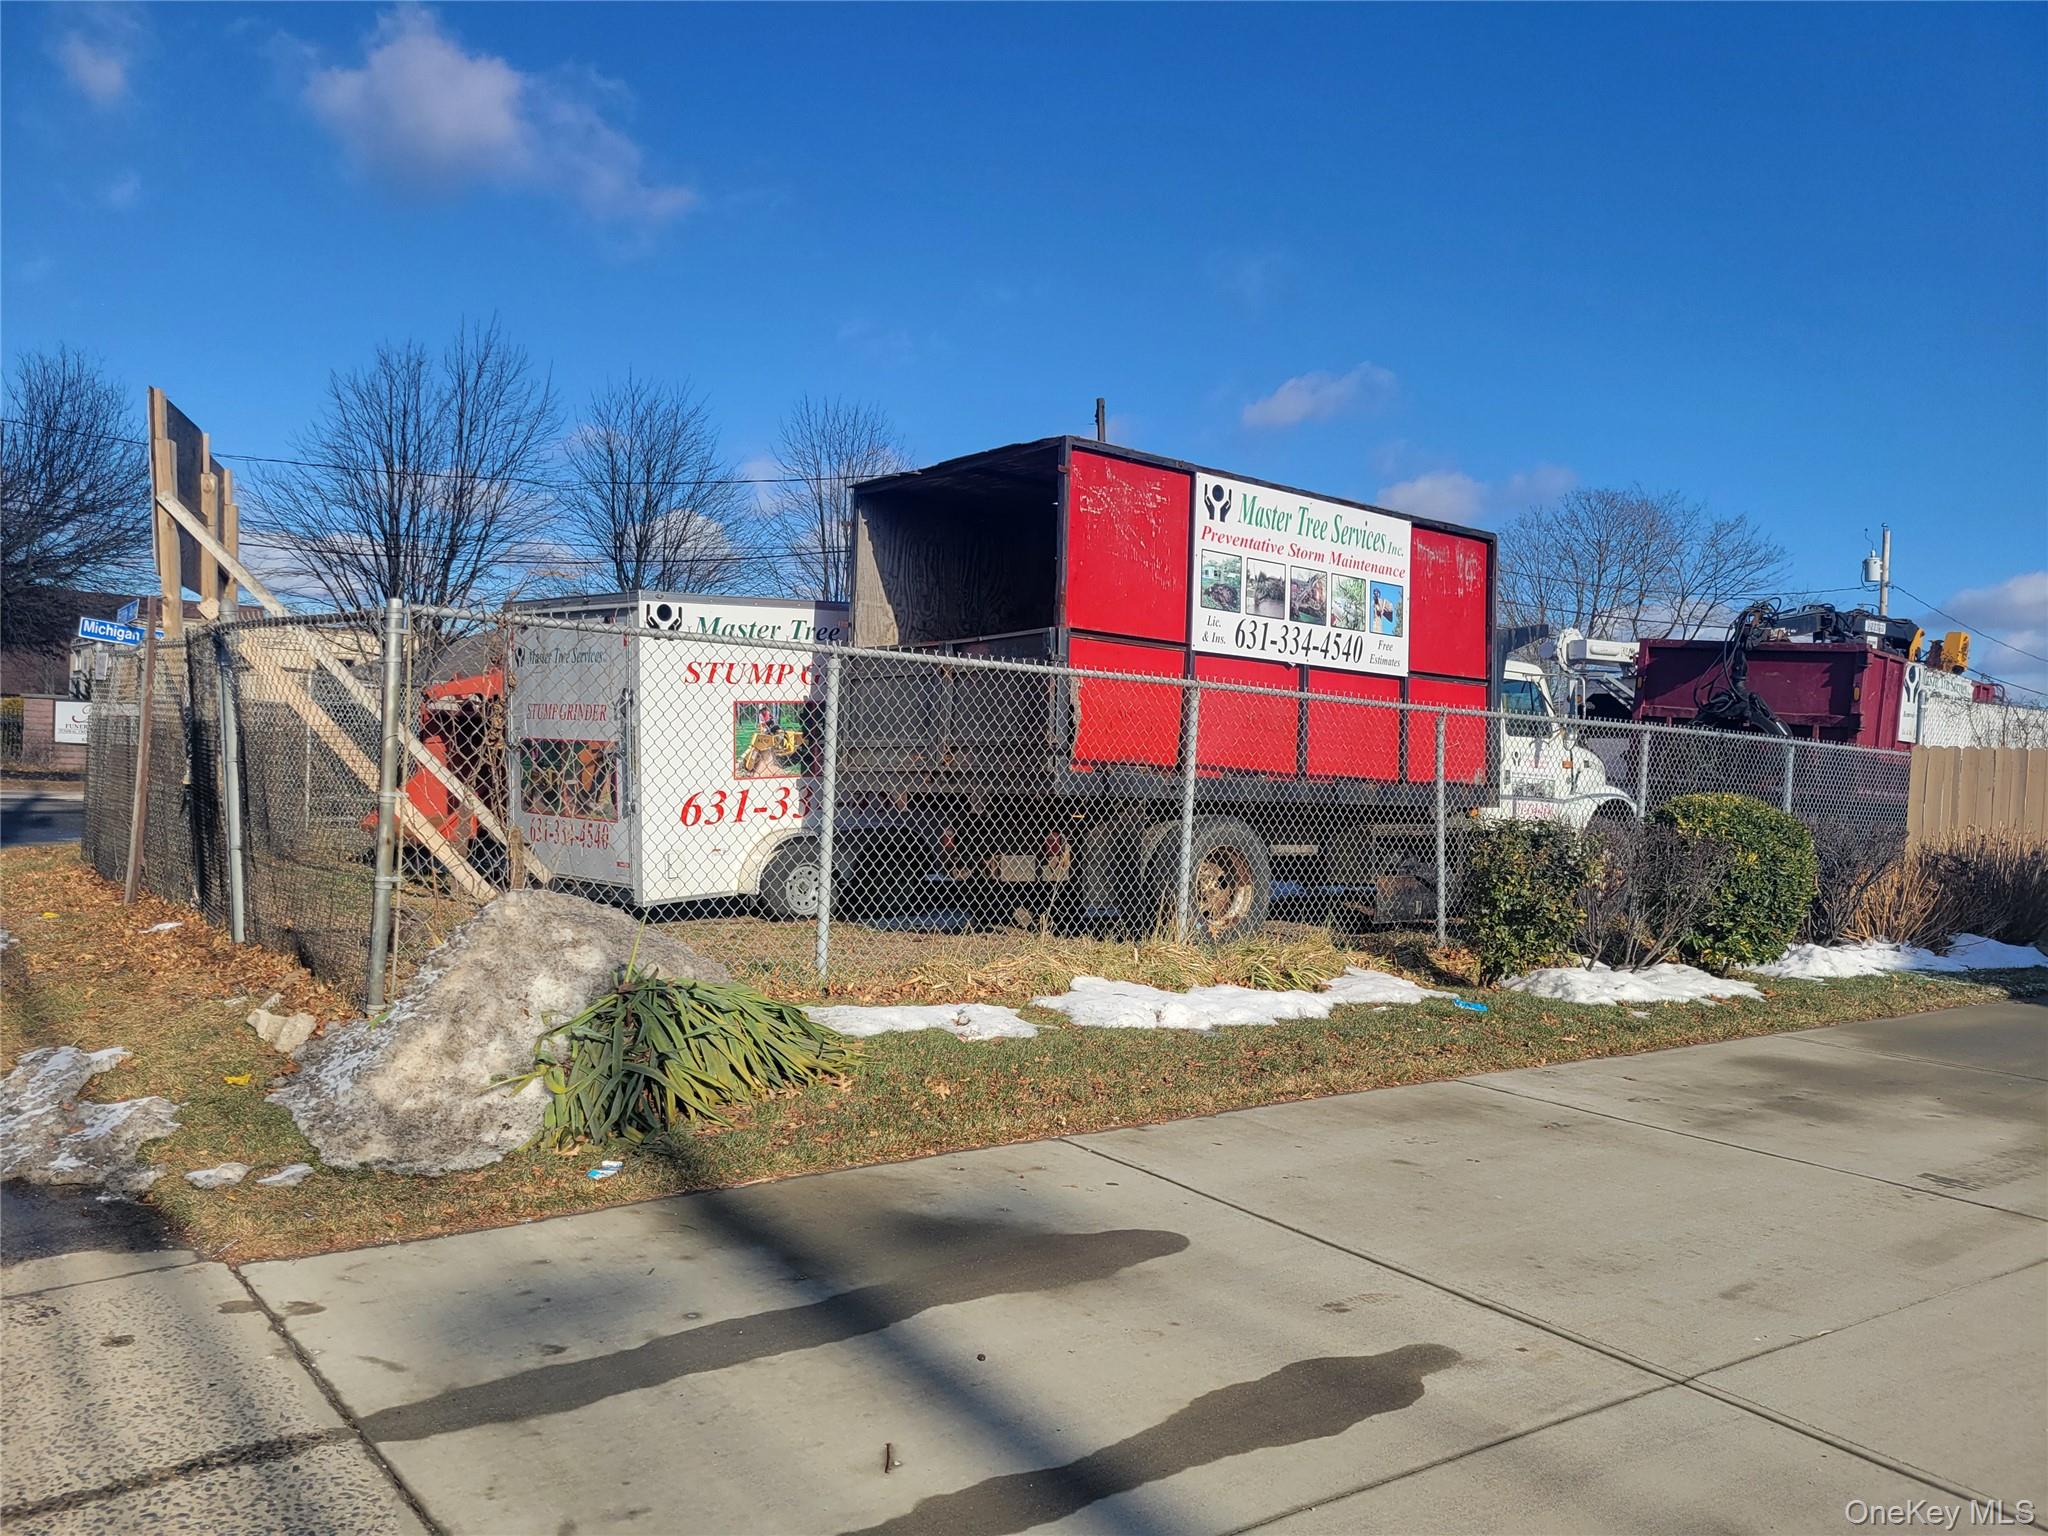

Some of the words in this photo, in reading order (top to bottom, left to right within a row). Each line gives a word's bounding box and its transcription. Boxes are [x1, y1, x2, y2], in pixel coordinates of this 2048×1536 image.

[1238, 493, 1293, 532] Master
[1297, 506, 1328, 540] Tree
[1331, 513, 1387, 553] Services
[1387, 541, 1404, 556] Inc.
[1201, 525, 1285, 555] Preventative
[1288, 543, 1325, 563] Storm
[1329, 551, 1406, 578] Maintenance
[83, 619, 140, 641] Michigan
[695, 616, 782, 640] Master
[792, 619, 841, 641] Tree
[1207, 615, 1221, 629] Lic.
[1202, 632, 1210, 642] &
[1212, 631, 1226, 645] Ins.
[1234, 618, 1363, 663] 631-334-4540
[1377, 640, 1394, 652] Free
[1369, 653, 1401, 668] Estimates
[685, 660, 794, 685] STUMP
[527, 703, 558, 720] STUMP
[560, 703, 607, 721] GRINDER
